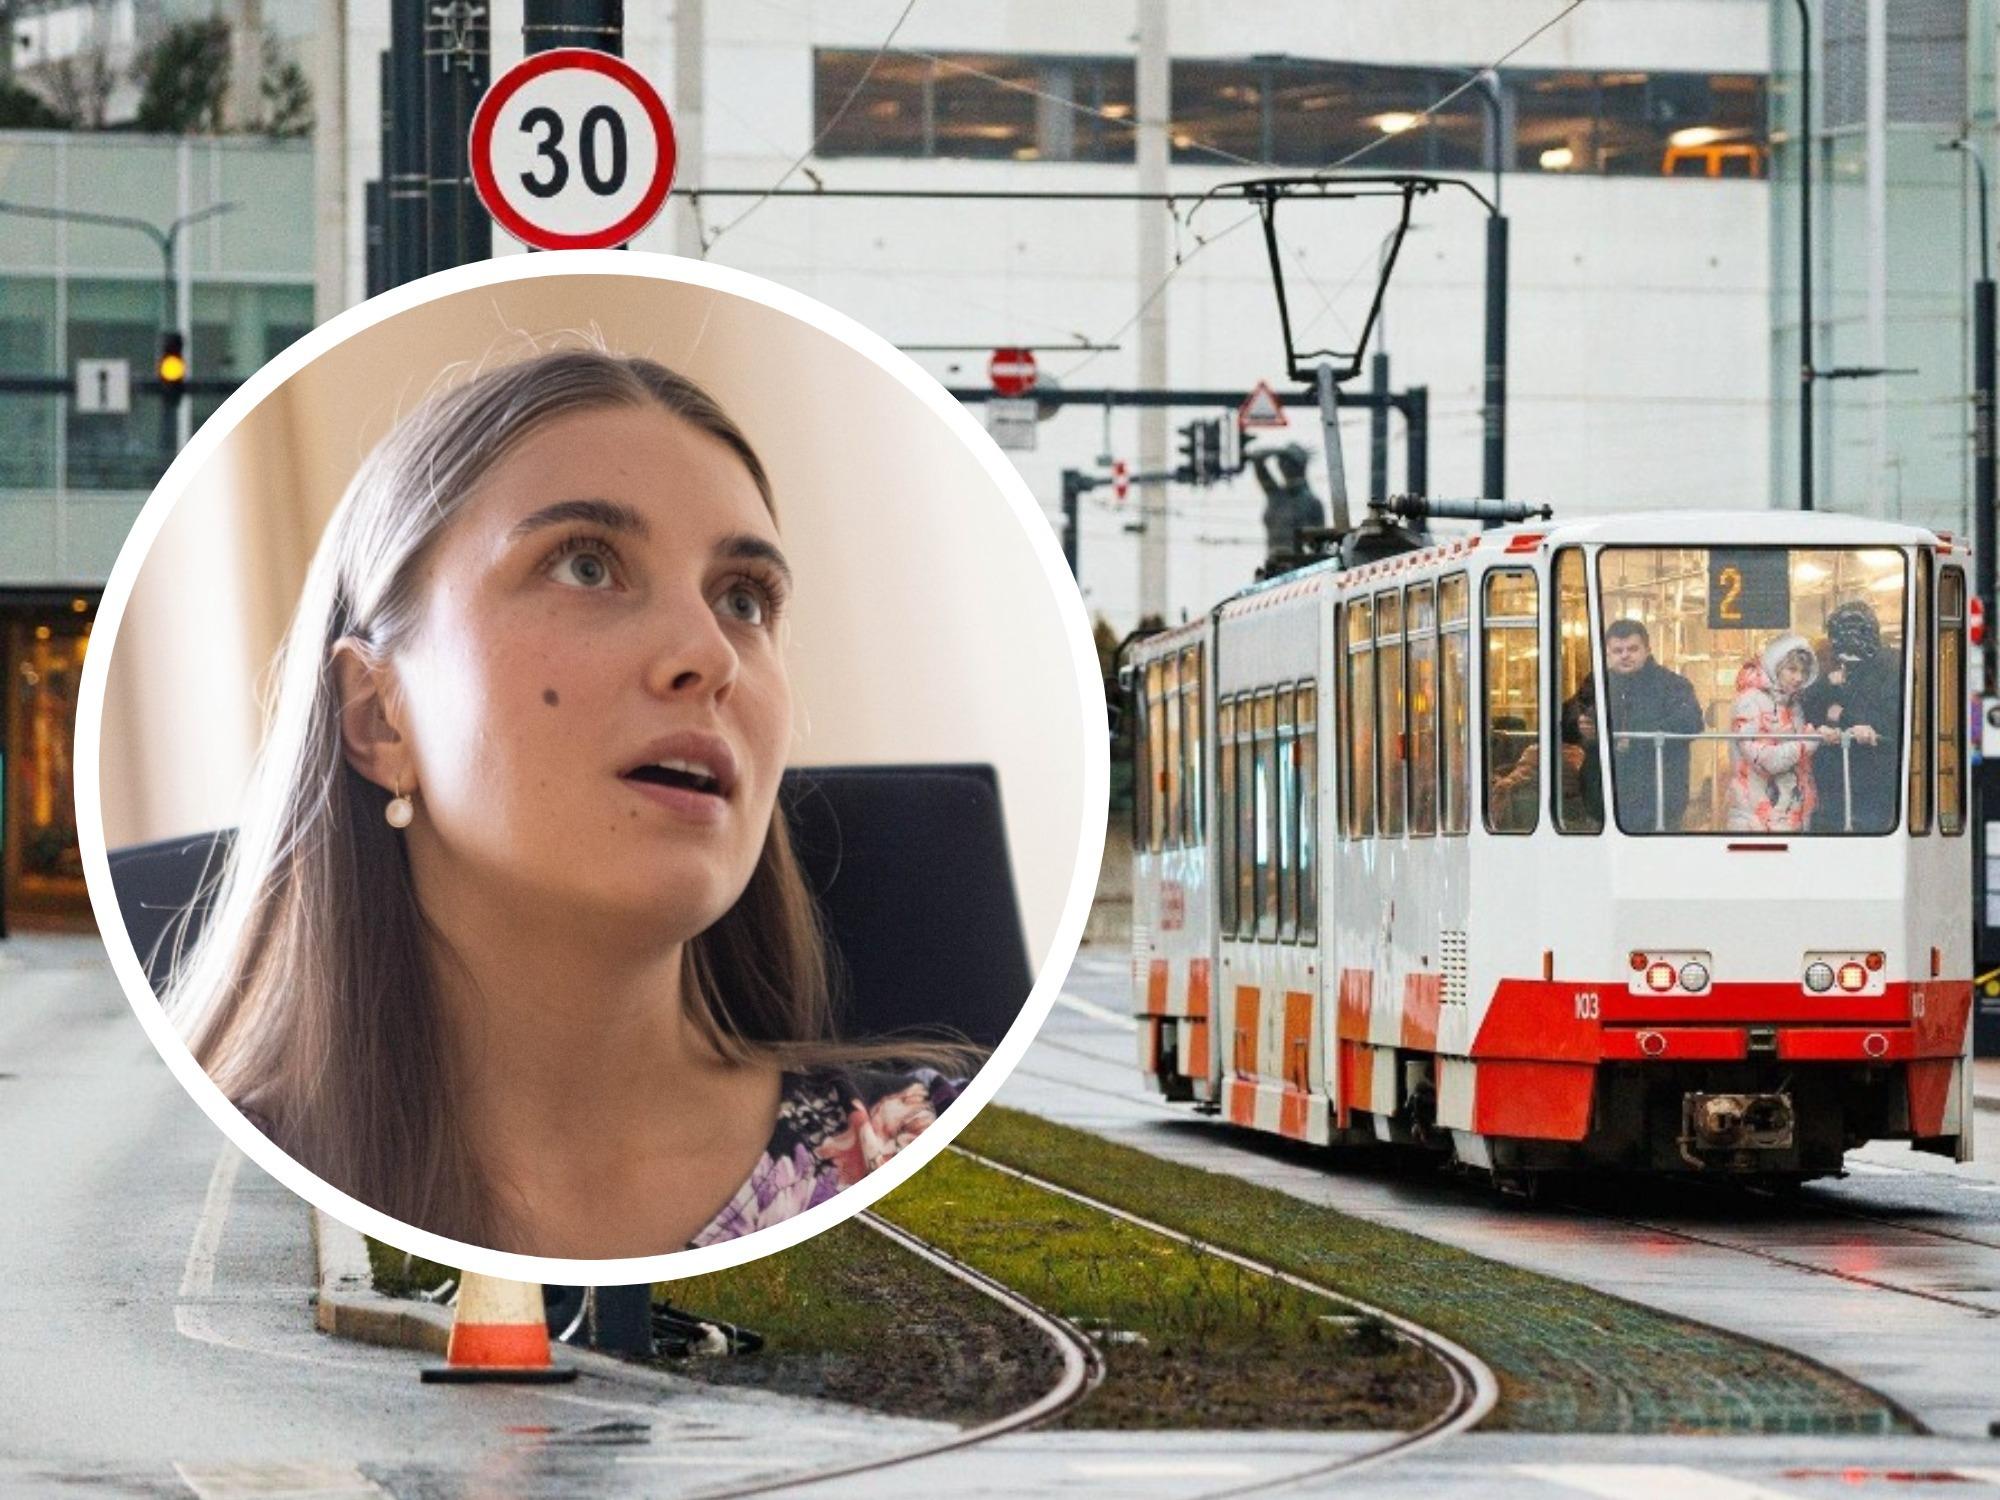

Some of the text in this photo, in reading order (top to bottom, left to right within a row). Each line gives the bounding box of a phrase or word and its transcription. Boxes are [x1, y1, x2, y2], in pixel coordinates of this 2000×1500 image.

[519, 105, 627, 198] 30
[1719, 566, 1742, 619] 2
[1575, 992, 1599, 1019] 103
